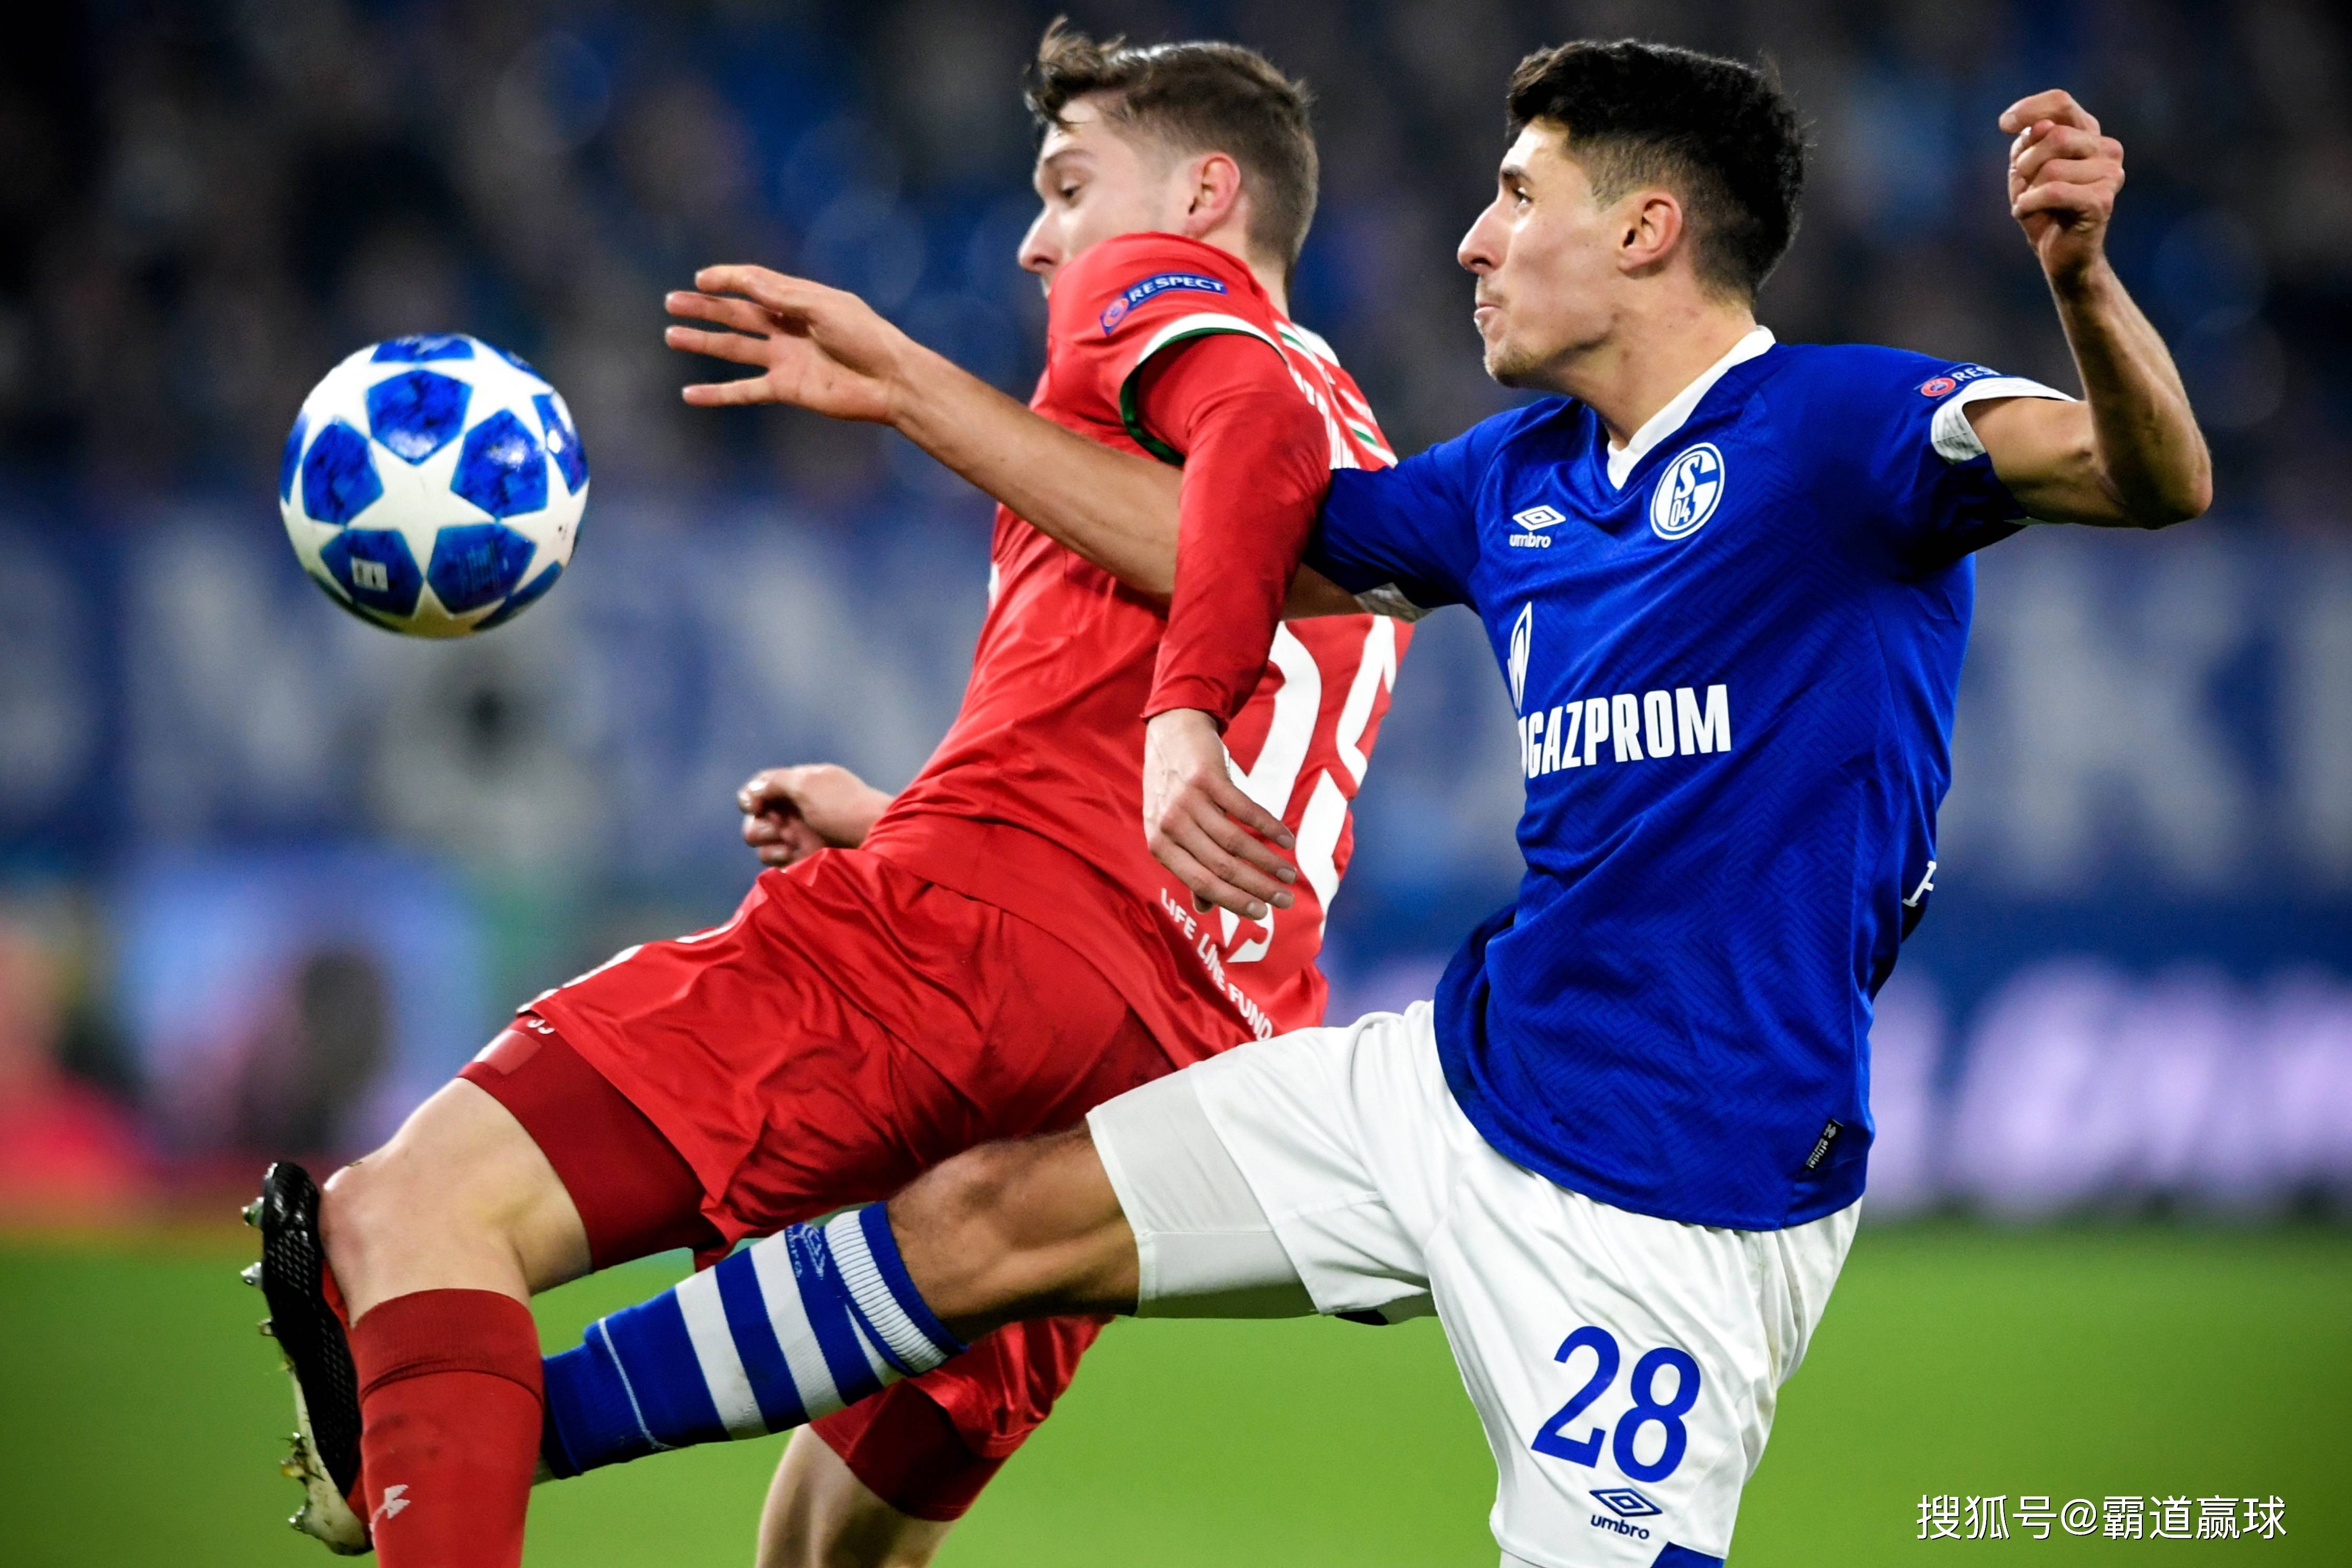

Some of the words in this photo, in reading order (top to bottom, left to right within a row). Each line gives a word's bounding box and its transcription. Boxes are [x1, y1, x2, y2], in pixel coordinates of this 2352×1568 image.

[1128, 276, 1224, 302] RESPECT
[1509, 532, 1551, 548] umbro
[1528, 684, 1731, 779] GAZPROM
[1161, 887, 1197, 940] LIFE
[1197, 933, 1226, 991] LINE
[1227, 982, 1273, 1041] FUND
[1531, 1326, 1701, 1483] 28
[1590, 1515, 1650, 1540] umbro
